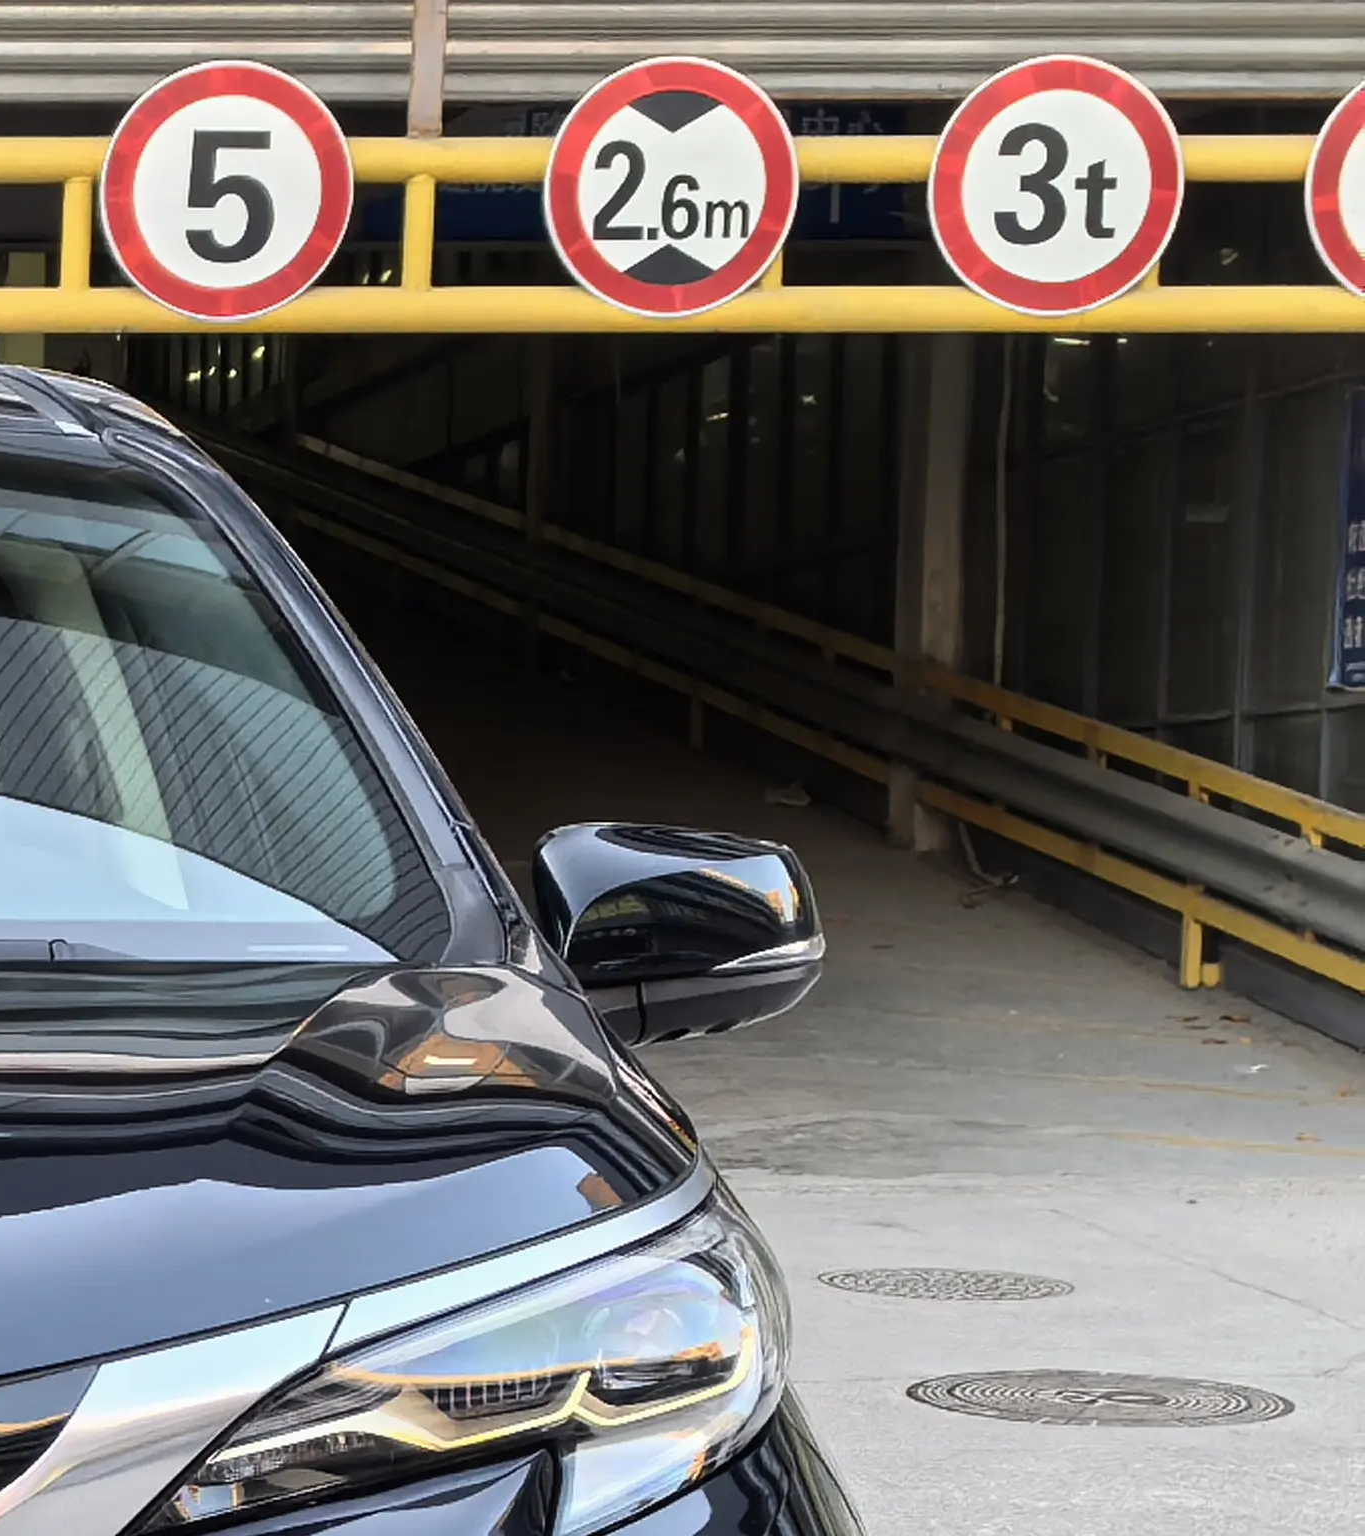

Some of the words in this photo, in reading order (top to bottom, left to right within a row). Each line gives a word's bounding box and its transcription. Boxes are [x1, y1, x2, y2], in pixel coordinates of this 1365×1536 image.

[184, 129, 275, 264] 5
[592, 139, 751, 242] 2.6m
[993, 122, 1119, 246] 3t
